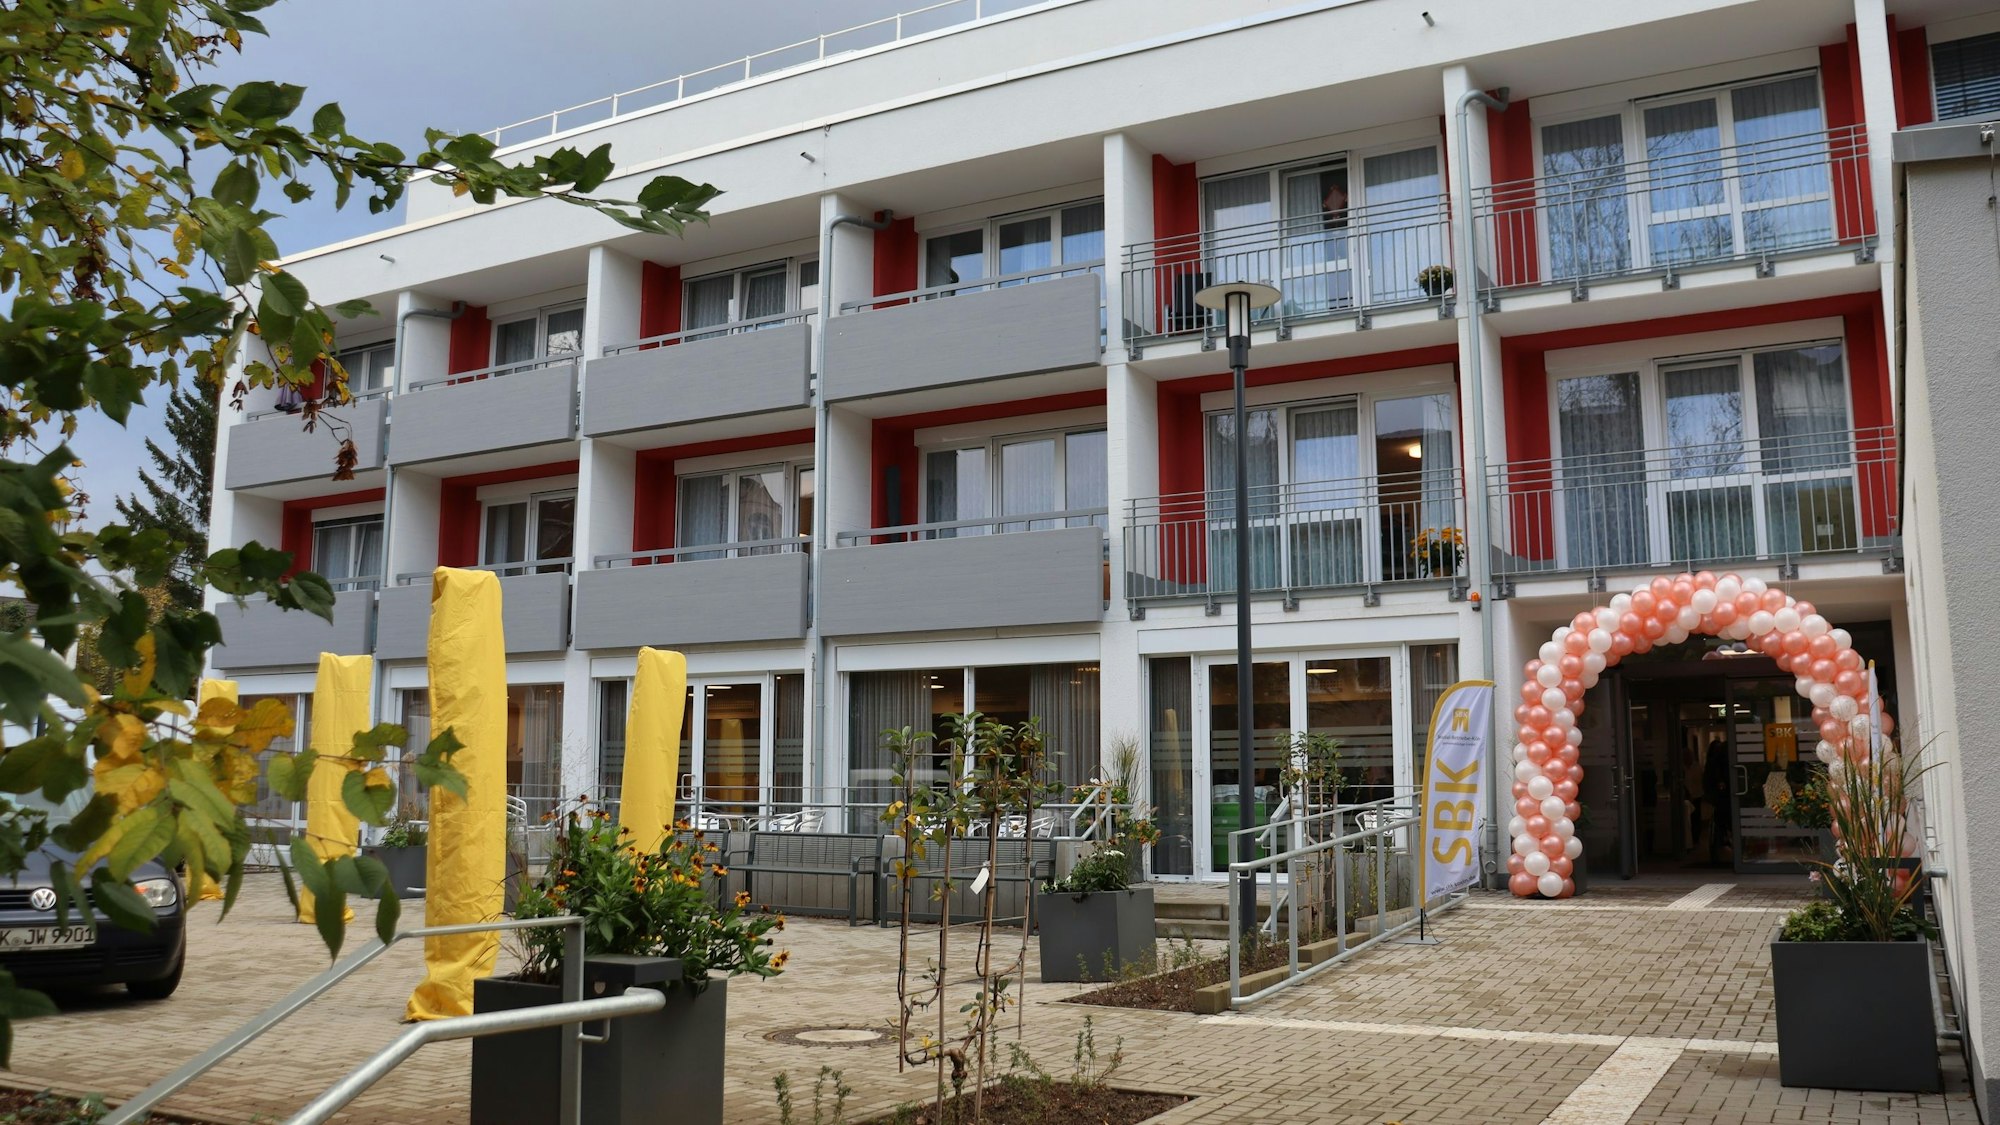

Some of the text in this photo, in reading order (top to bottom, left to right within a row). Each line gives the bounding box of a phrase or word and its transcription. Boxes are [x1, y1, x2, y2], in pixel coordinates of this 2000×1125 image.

[1454, 710, 1469, 718] SBK
[1769, 727, 1793, 738] SBK
[1432, 758, 1479, 866] SBK
[33, 888, 56, 909] VW
[0, 926, 95, 946] K JW 9901
